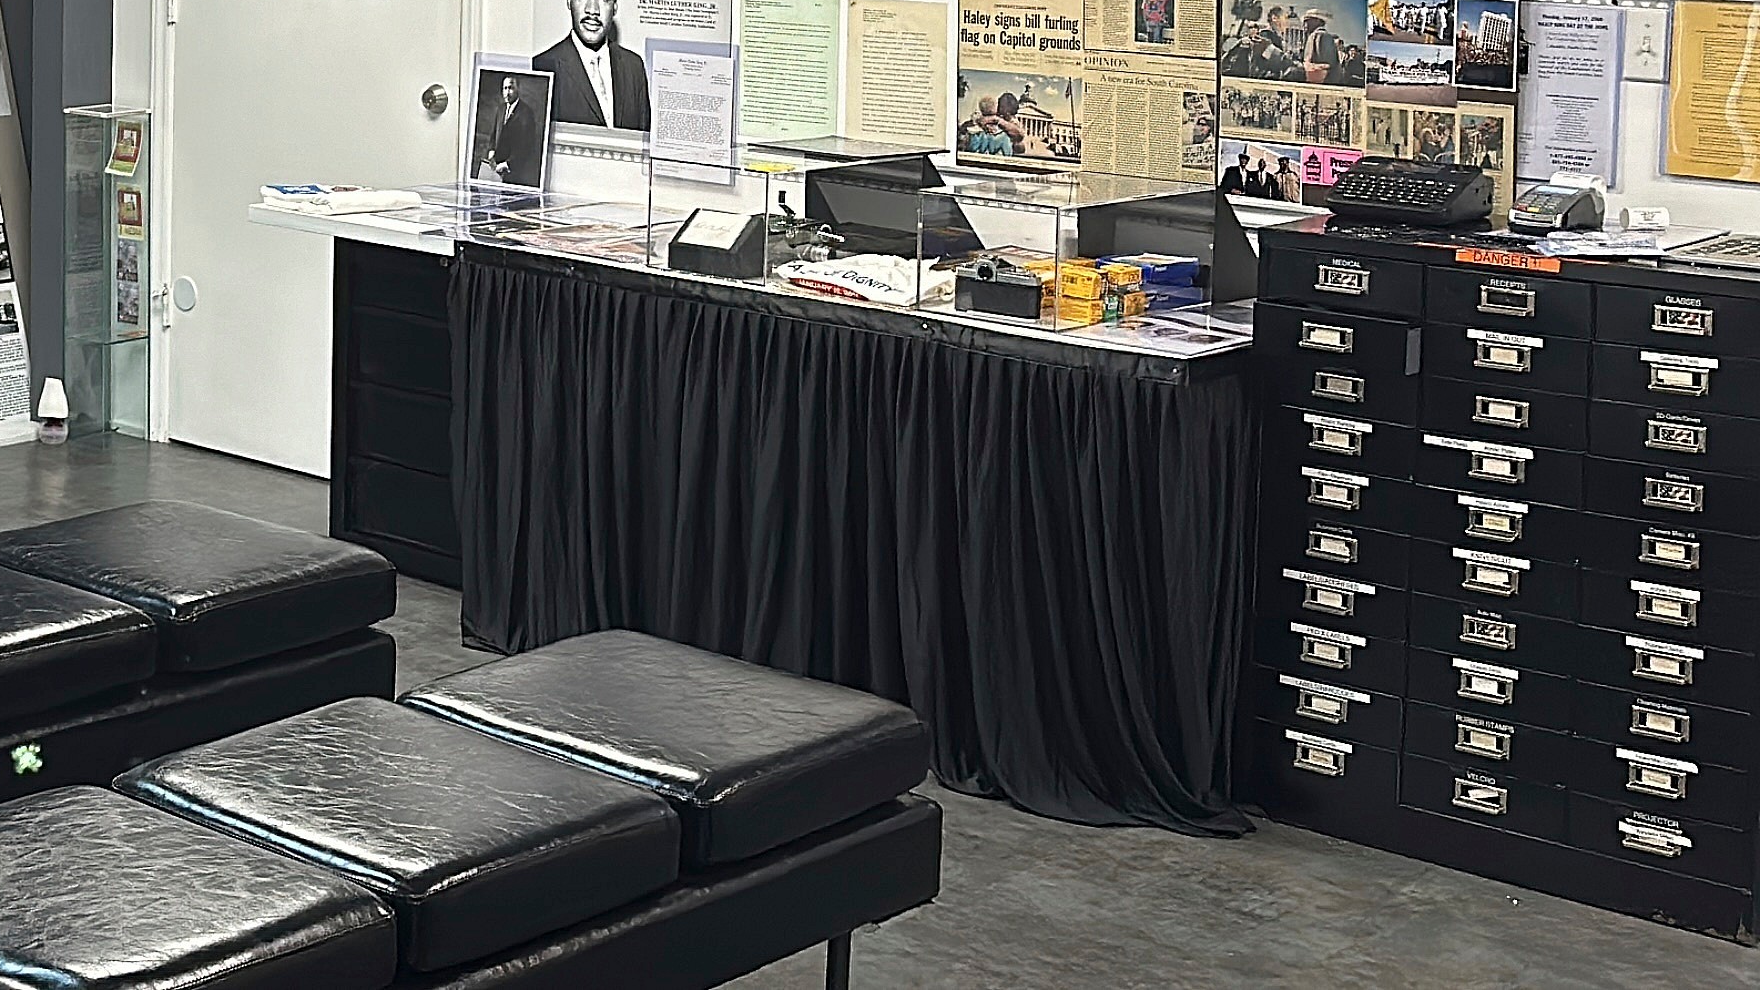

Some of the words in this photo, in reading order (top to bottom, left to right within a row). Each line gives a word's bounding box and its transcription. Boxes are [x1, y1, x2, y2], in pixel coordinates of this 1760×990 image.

[964, 10, 990, 28] Haley
[995, 13, 1021, 29] signs
[1025, 12, 1040, 27] bill
[1044, 14, 1079, 34] furling
[960, 28, 980, 46] flag
[984, 32, 996, 44] on
[999, 30, 1036, 48] Capitol
[1040, 35, 1081, 51] grounds
[1084, 57, 1130, 68] OPINION
[1147, 78, 1166, 87] South
[1473, 253, 1528, 269] DANGER
[1490, 278, 1526, 289] RECEIPTS
[1665, 295, 1702, 307] GLASSES
[1466, 772, 1496, 785] VELCRO
[1633, 811, 1679, 829] PROJECTOR
